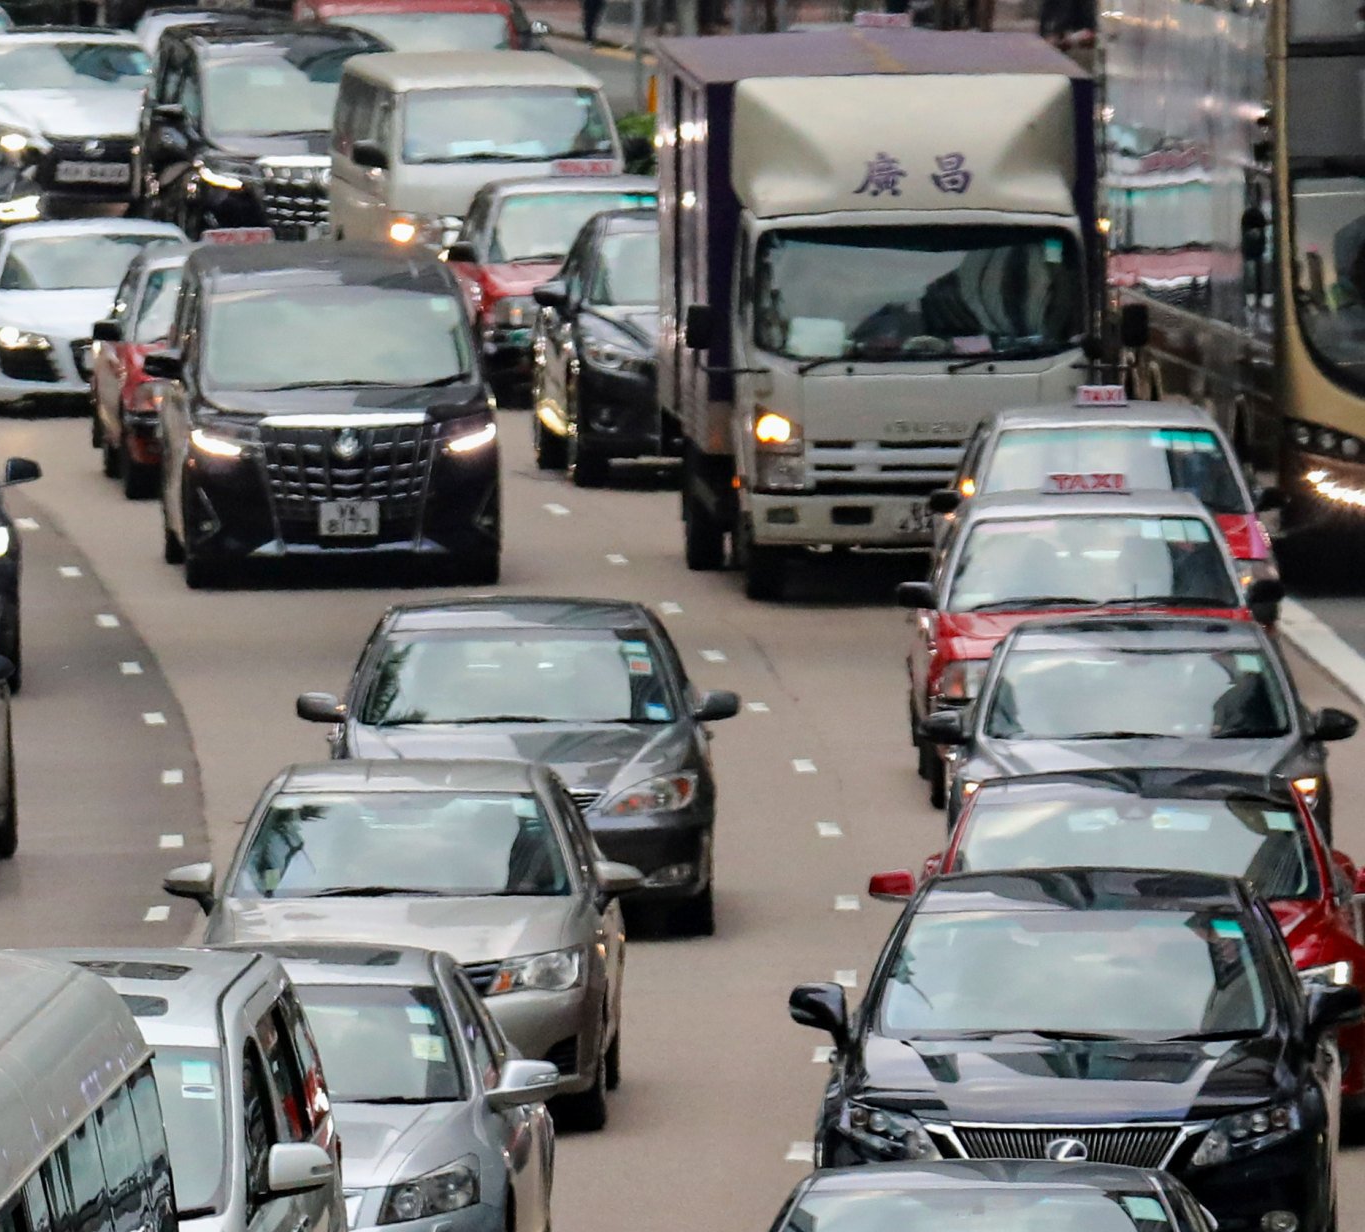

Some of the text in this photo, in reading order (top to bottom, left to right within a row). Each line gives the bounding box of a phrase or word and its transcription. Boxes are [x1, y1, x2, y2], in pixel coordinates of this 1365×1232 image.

[853, 152, 972, 196] 廣昌
[1082, 389, 1122, 401] TAXI
[1050, 473, 1123, 489] TAXI
